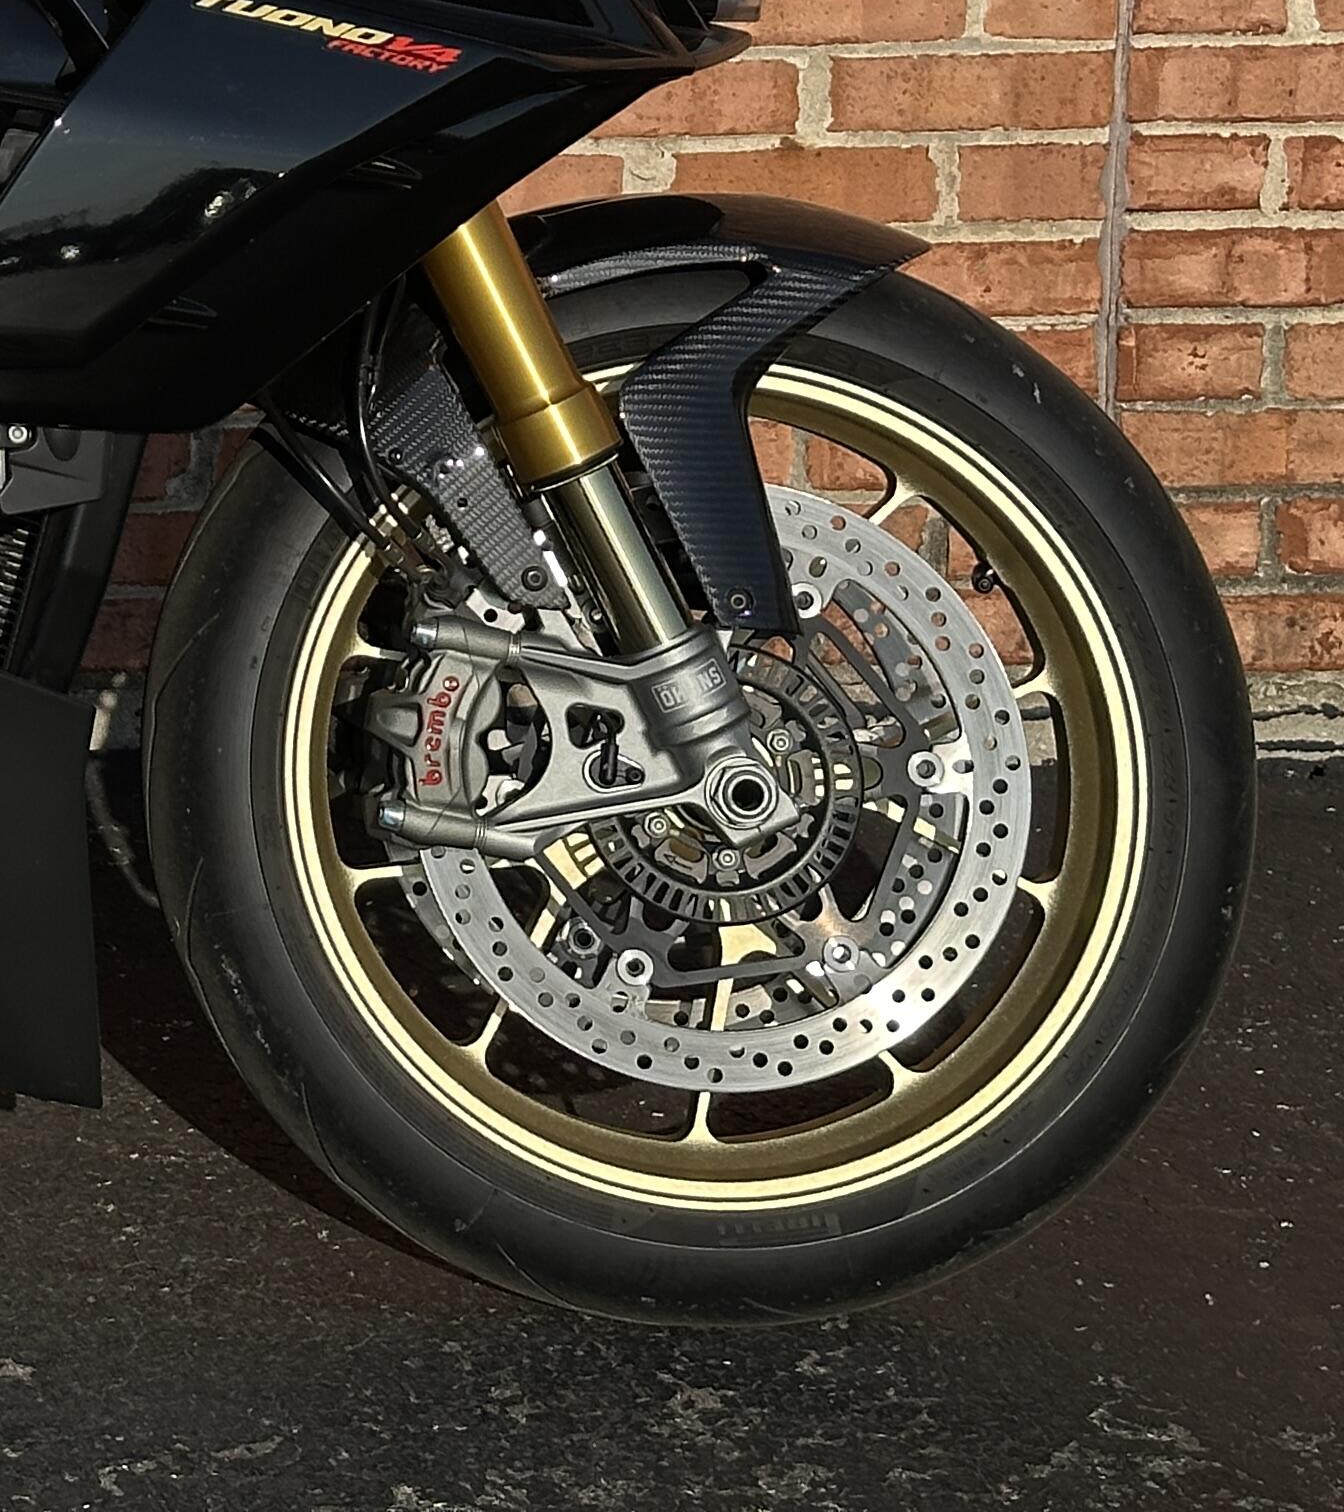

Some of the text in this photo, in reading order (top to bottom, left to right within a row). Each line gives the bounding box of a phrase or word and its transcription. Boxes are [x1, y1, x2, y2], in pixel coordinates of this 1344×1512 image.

[326, 38, 450, 74] FACTORY
[385, 35, 463, 63] V4
[656, 665, 722, 708] ÖHNS
[418, 675, 460, 787] brembo
